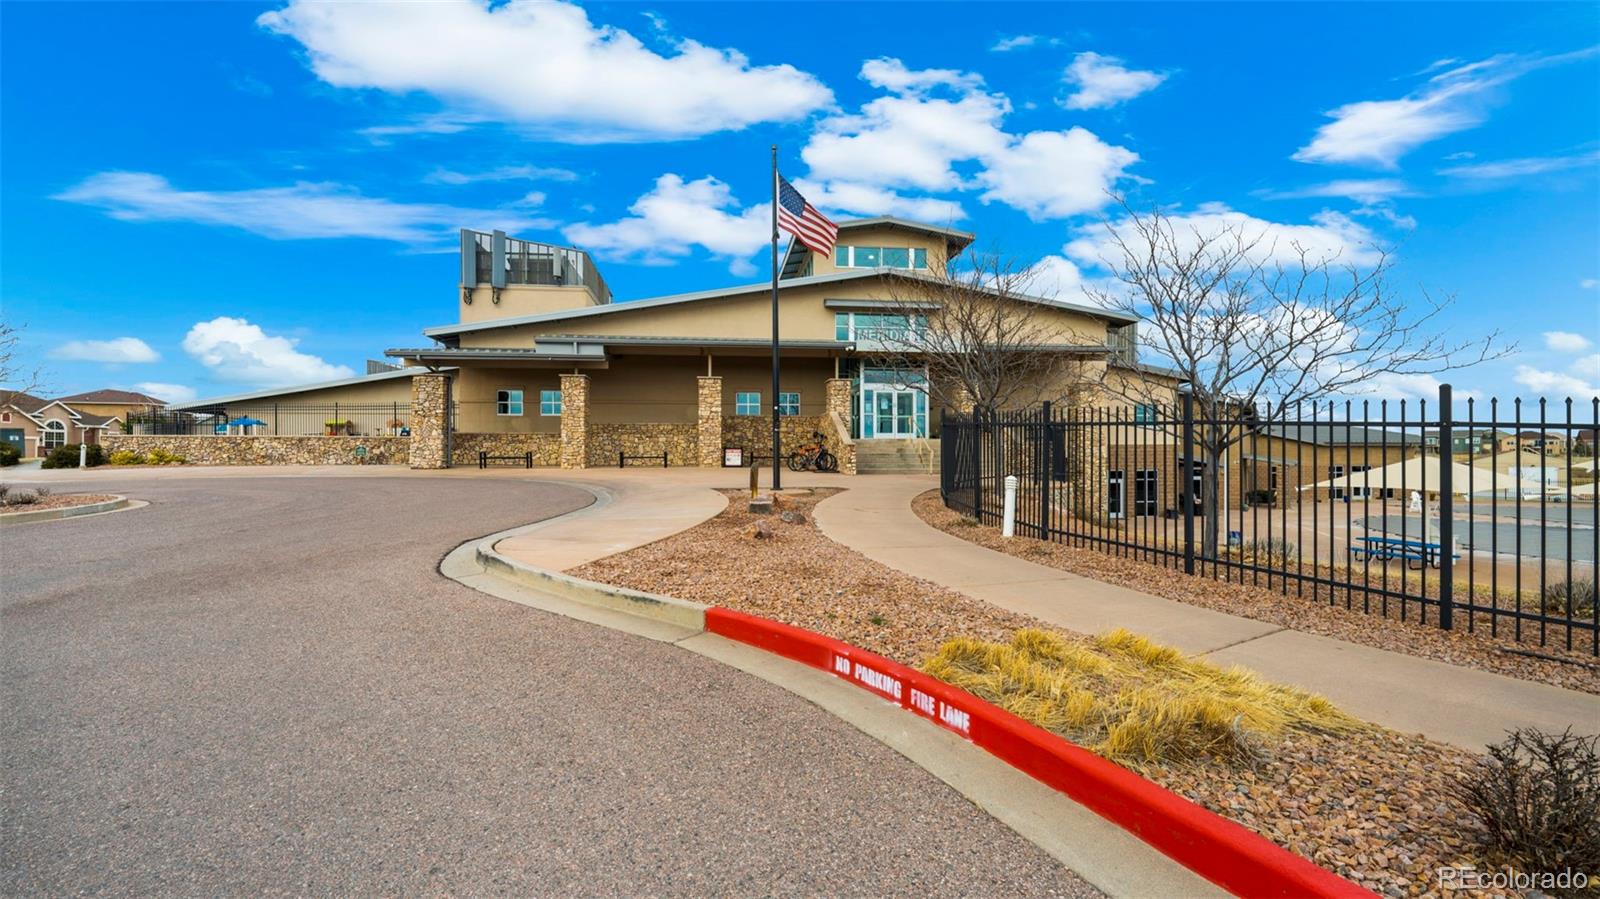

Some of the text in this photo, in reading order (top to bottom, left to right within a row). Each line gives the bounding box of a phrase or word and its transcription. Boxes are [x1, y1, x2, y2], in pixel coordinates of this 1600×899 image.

[835, 655, 970, 734] NO PARKING FIRE LANE
